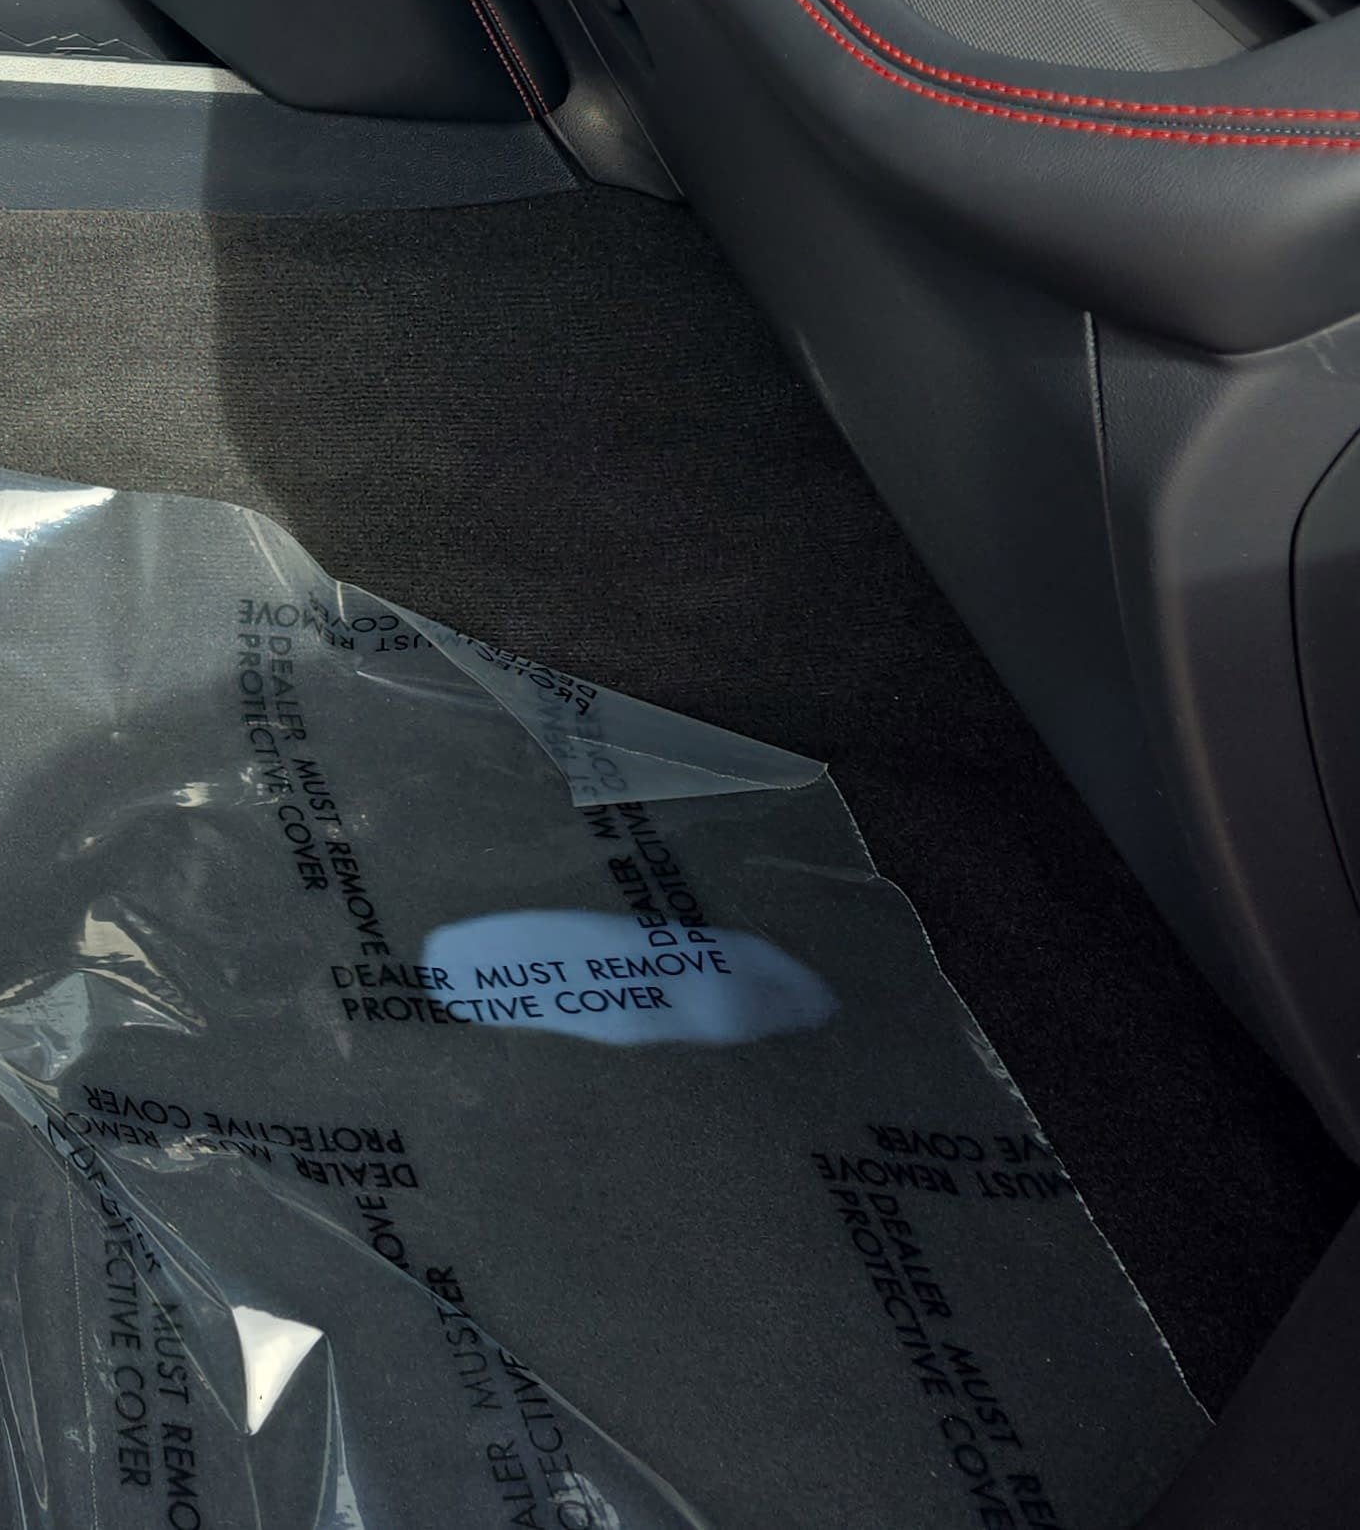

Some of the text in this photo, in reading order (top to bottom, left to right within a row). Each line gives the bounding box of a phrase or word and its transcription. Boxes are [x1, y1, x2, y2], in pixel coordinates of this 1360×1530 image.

[268, 636, 390, 957] DEALER MUST REMOVE
[278, 804, 329, 891] COVER
[607, 856, 678, 948] DEALER
[331, 950, 732, 991] DEALER MUST REMOVE
[341, 986, 673, 1025] PROTECTIVE COVER
[83, 1084, 406, 1154] PROTECTIVE COVER
[868, 1124, 985, 1162] COVER
[291, 1152, 419, 1189] DEALER
[810, 1152, 960, 1197] REMOVE
[829, 1188, 956, 1398] PROTECTIVE
[869, 1192, 952, 1319] DEALER
[941, 1342, 1023, 1449] MUST
[152, 1302, 191, 1406] MUST
[113, 1365, 152, 1487] COVER
